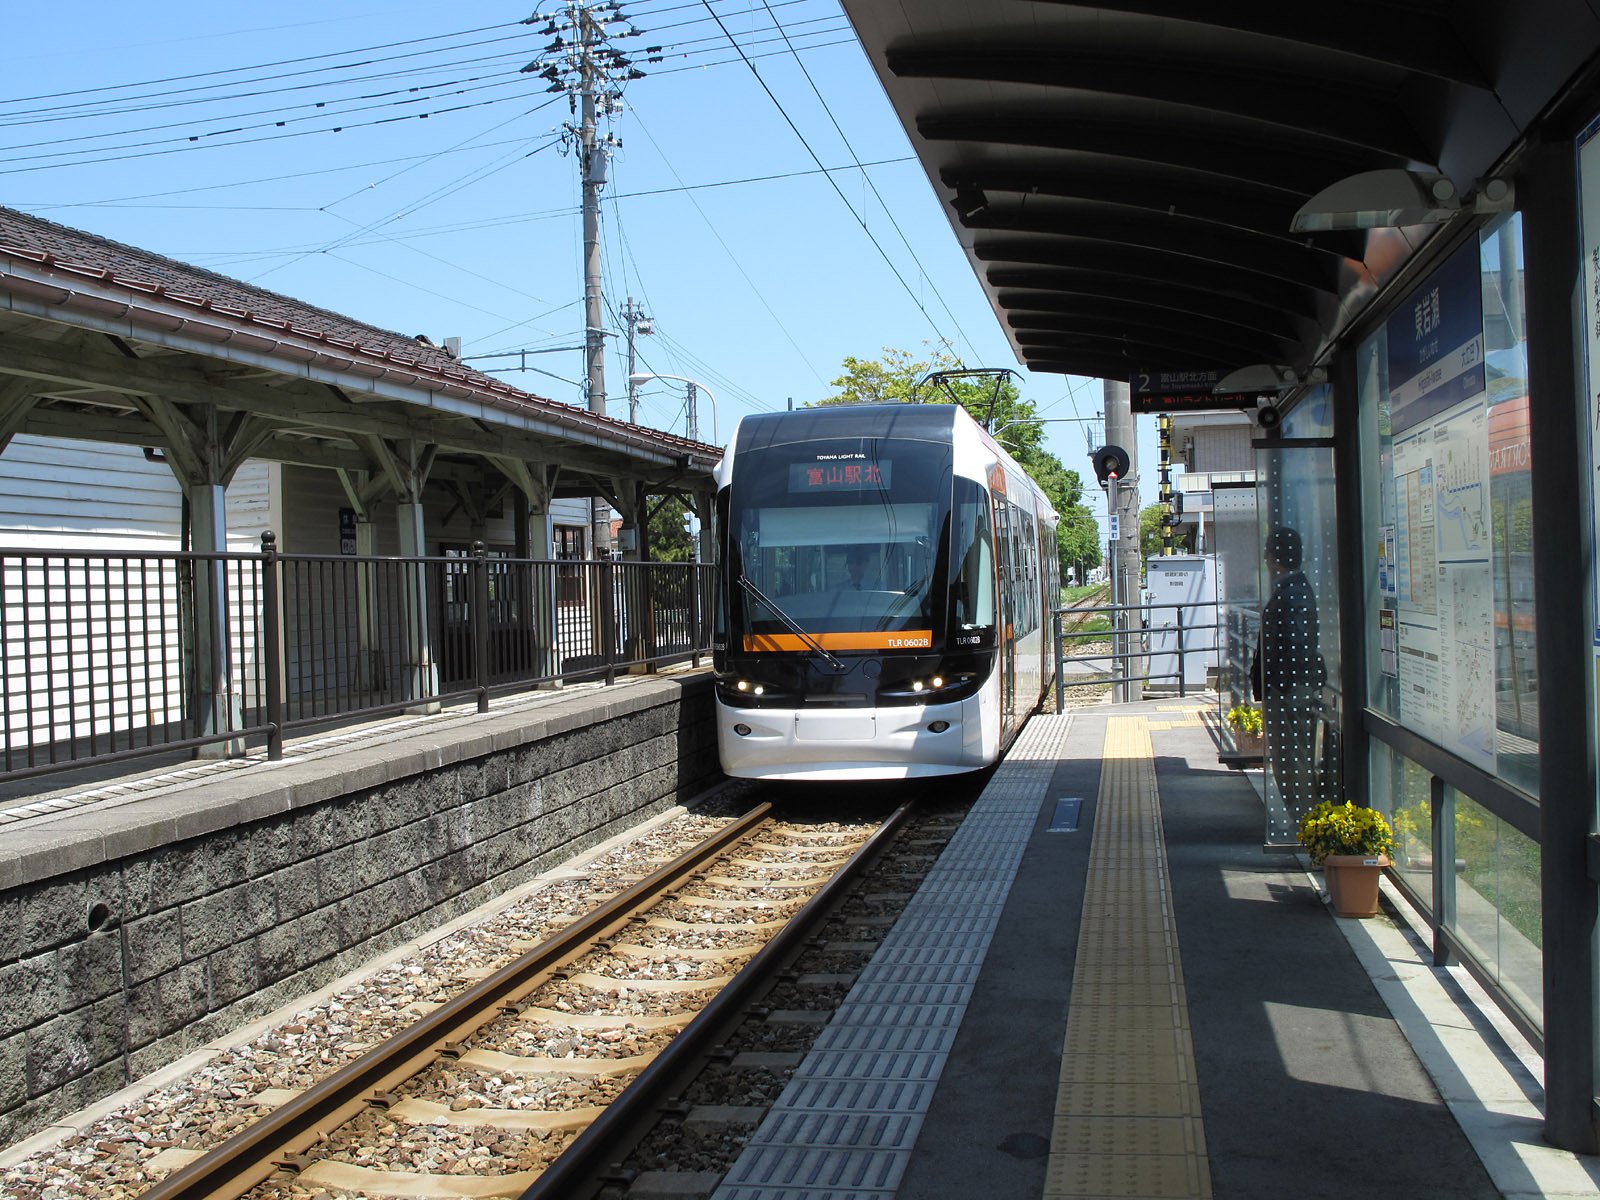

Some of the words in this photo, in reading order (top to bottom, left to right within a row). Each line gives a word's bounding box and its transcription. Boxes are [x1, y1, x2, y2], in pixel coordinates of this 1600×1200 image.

[1138, 373, 1151, 392] 2
[808, 464, 881, 485] 富山駅北
[888, 639, 902, 647] TLR
[904, 638, 929, 646] 0602B
[956, 637, 966, 645] TLR
